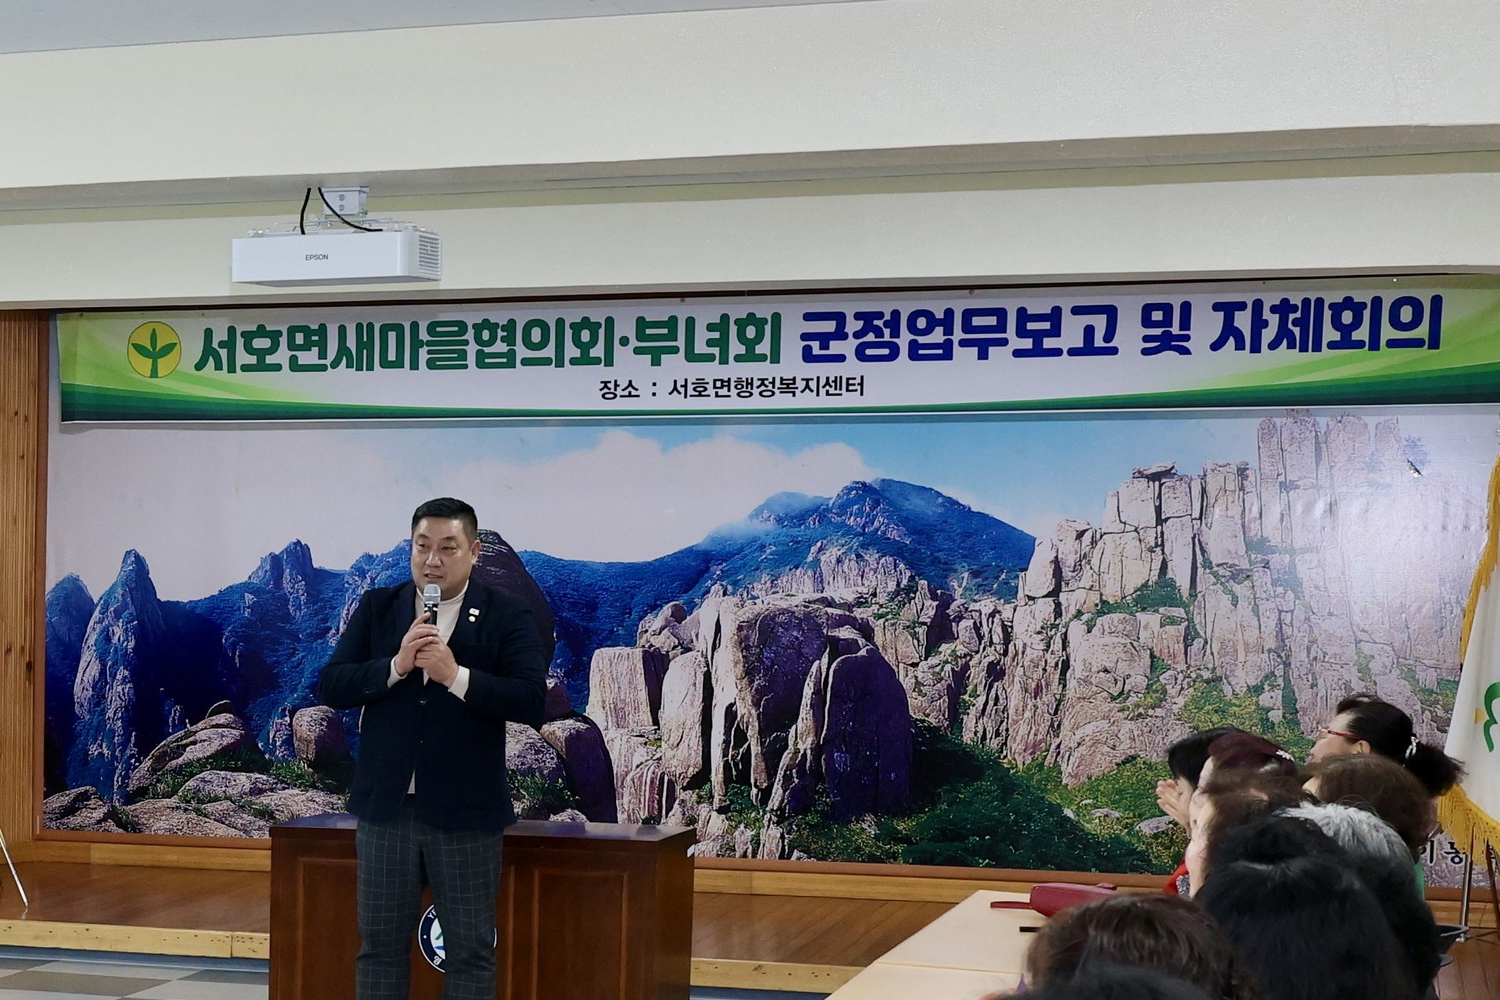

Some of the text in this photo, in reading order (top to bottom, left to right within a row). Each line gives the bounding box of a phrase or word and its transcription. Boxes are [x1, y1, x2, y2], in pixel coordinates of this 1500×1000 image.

[305, 253, 329, 261] EPSON
[194, 293, 1443, 375] 서호면새마을협의회·부녀회 군정업무보고 및 자체회의
[598, 378, 641, 400] 장소
[667, 375, 865, 399] 서호면행정복지센터
